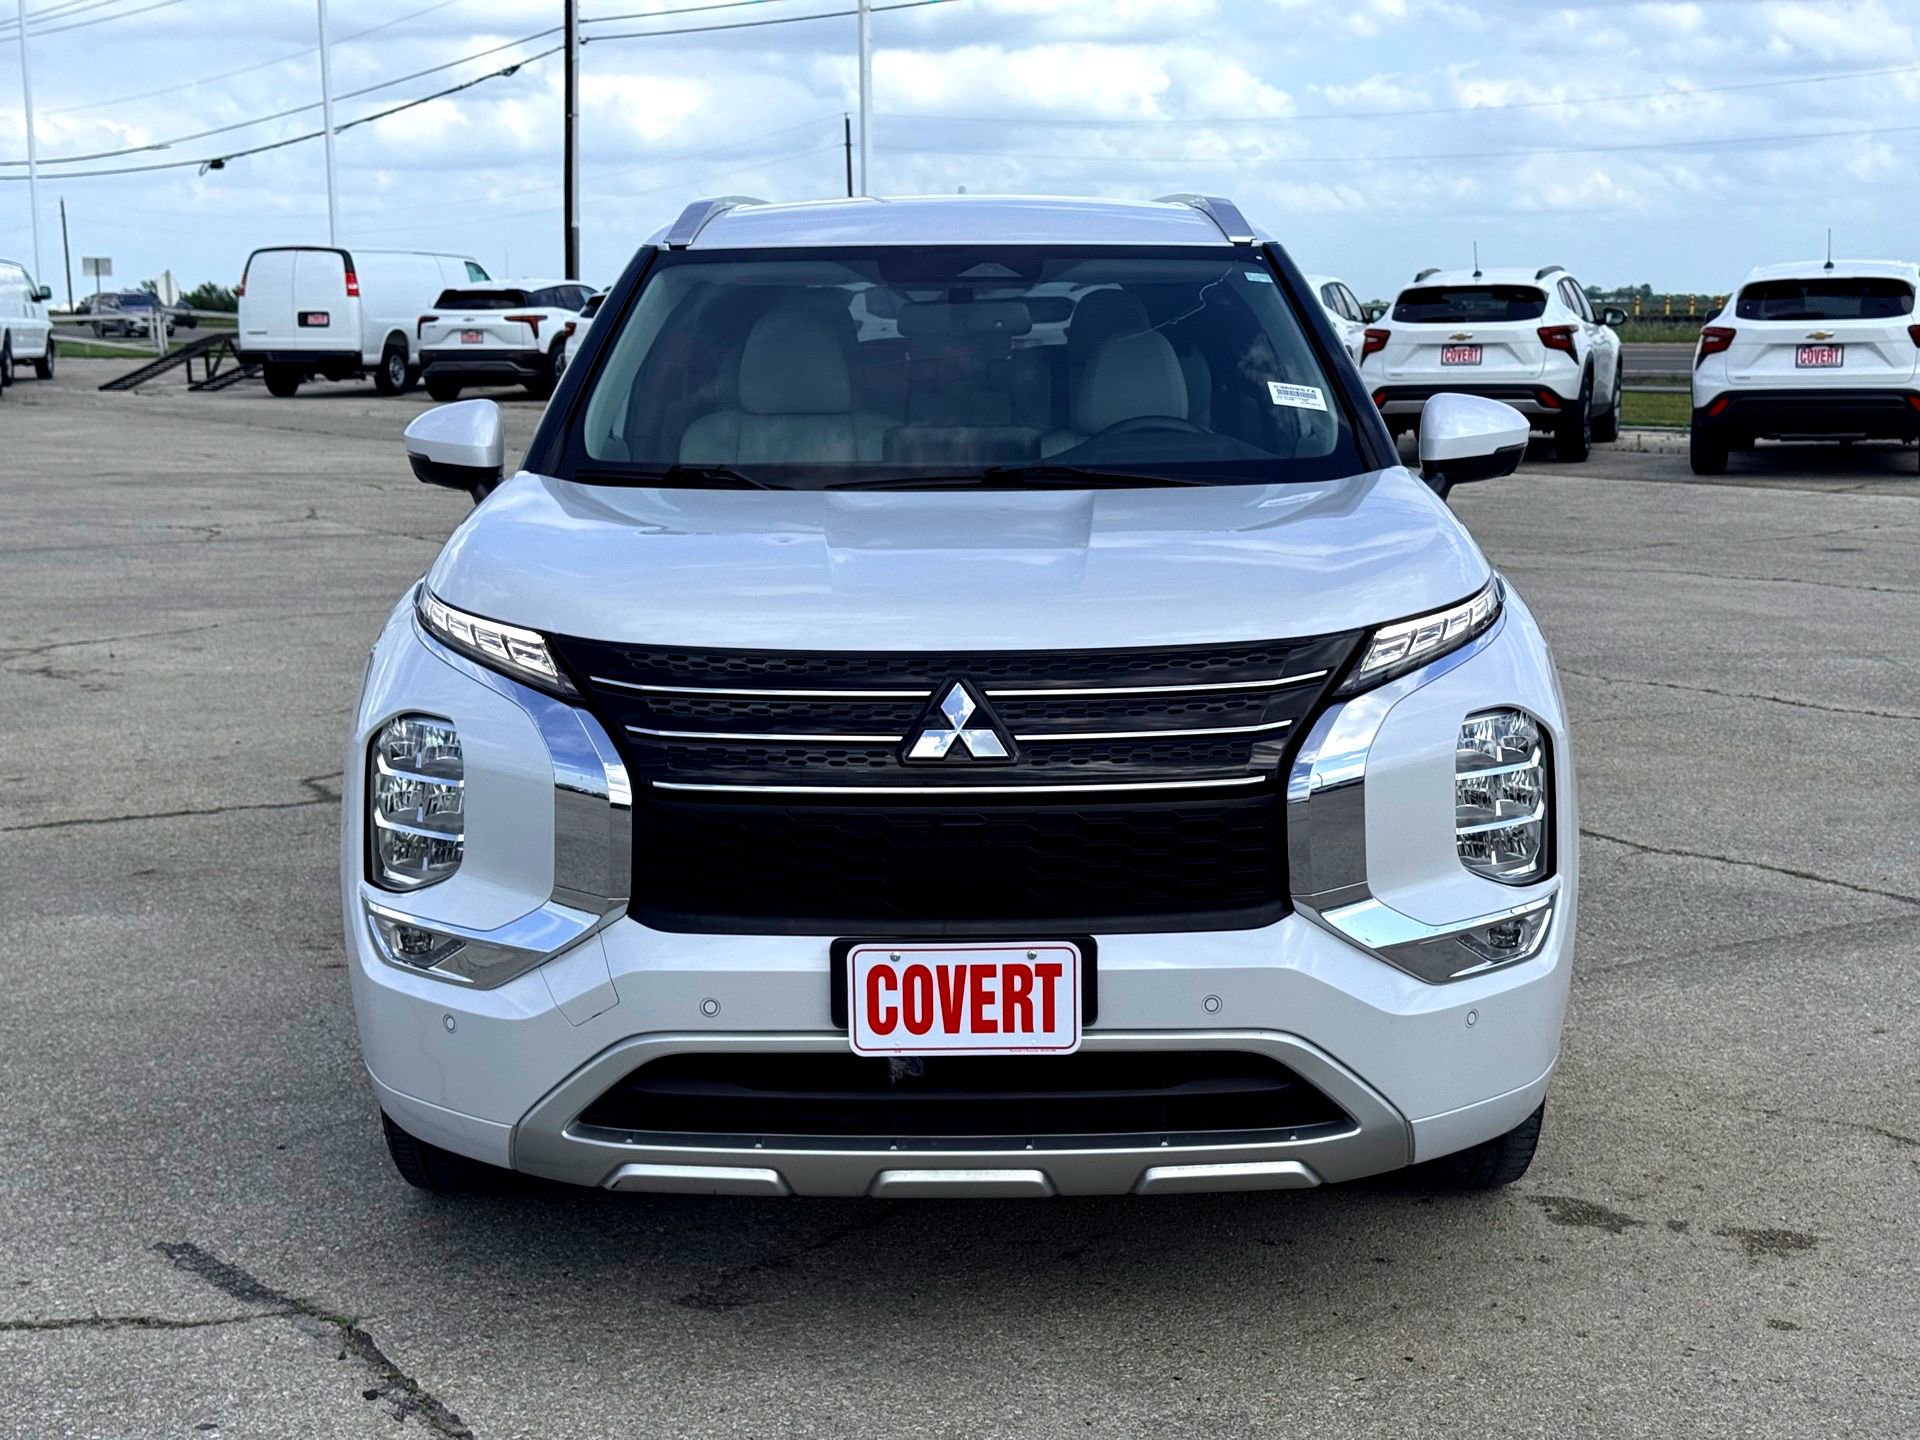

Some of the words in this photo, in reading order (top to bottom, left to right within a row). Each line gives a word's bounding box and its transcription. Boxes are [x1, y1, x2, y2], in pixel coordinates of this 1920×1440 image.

[1445, 347, 1478, 362] COVERT
[1800, 347, 1840, 363] COVERT
[866, 963, 1062, 1035] COVERT
